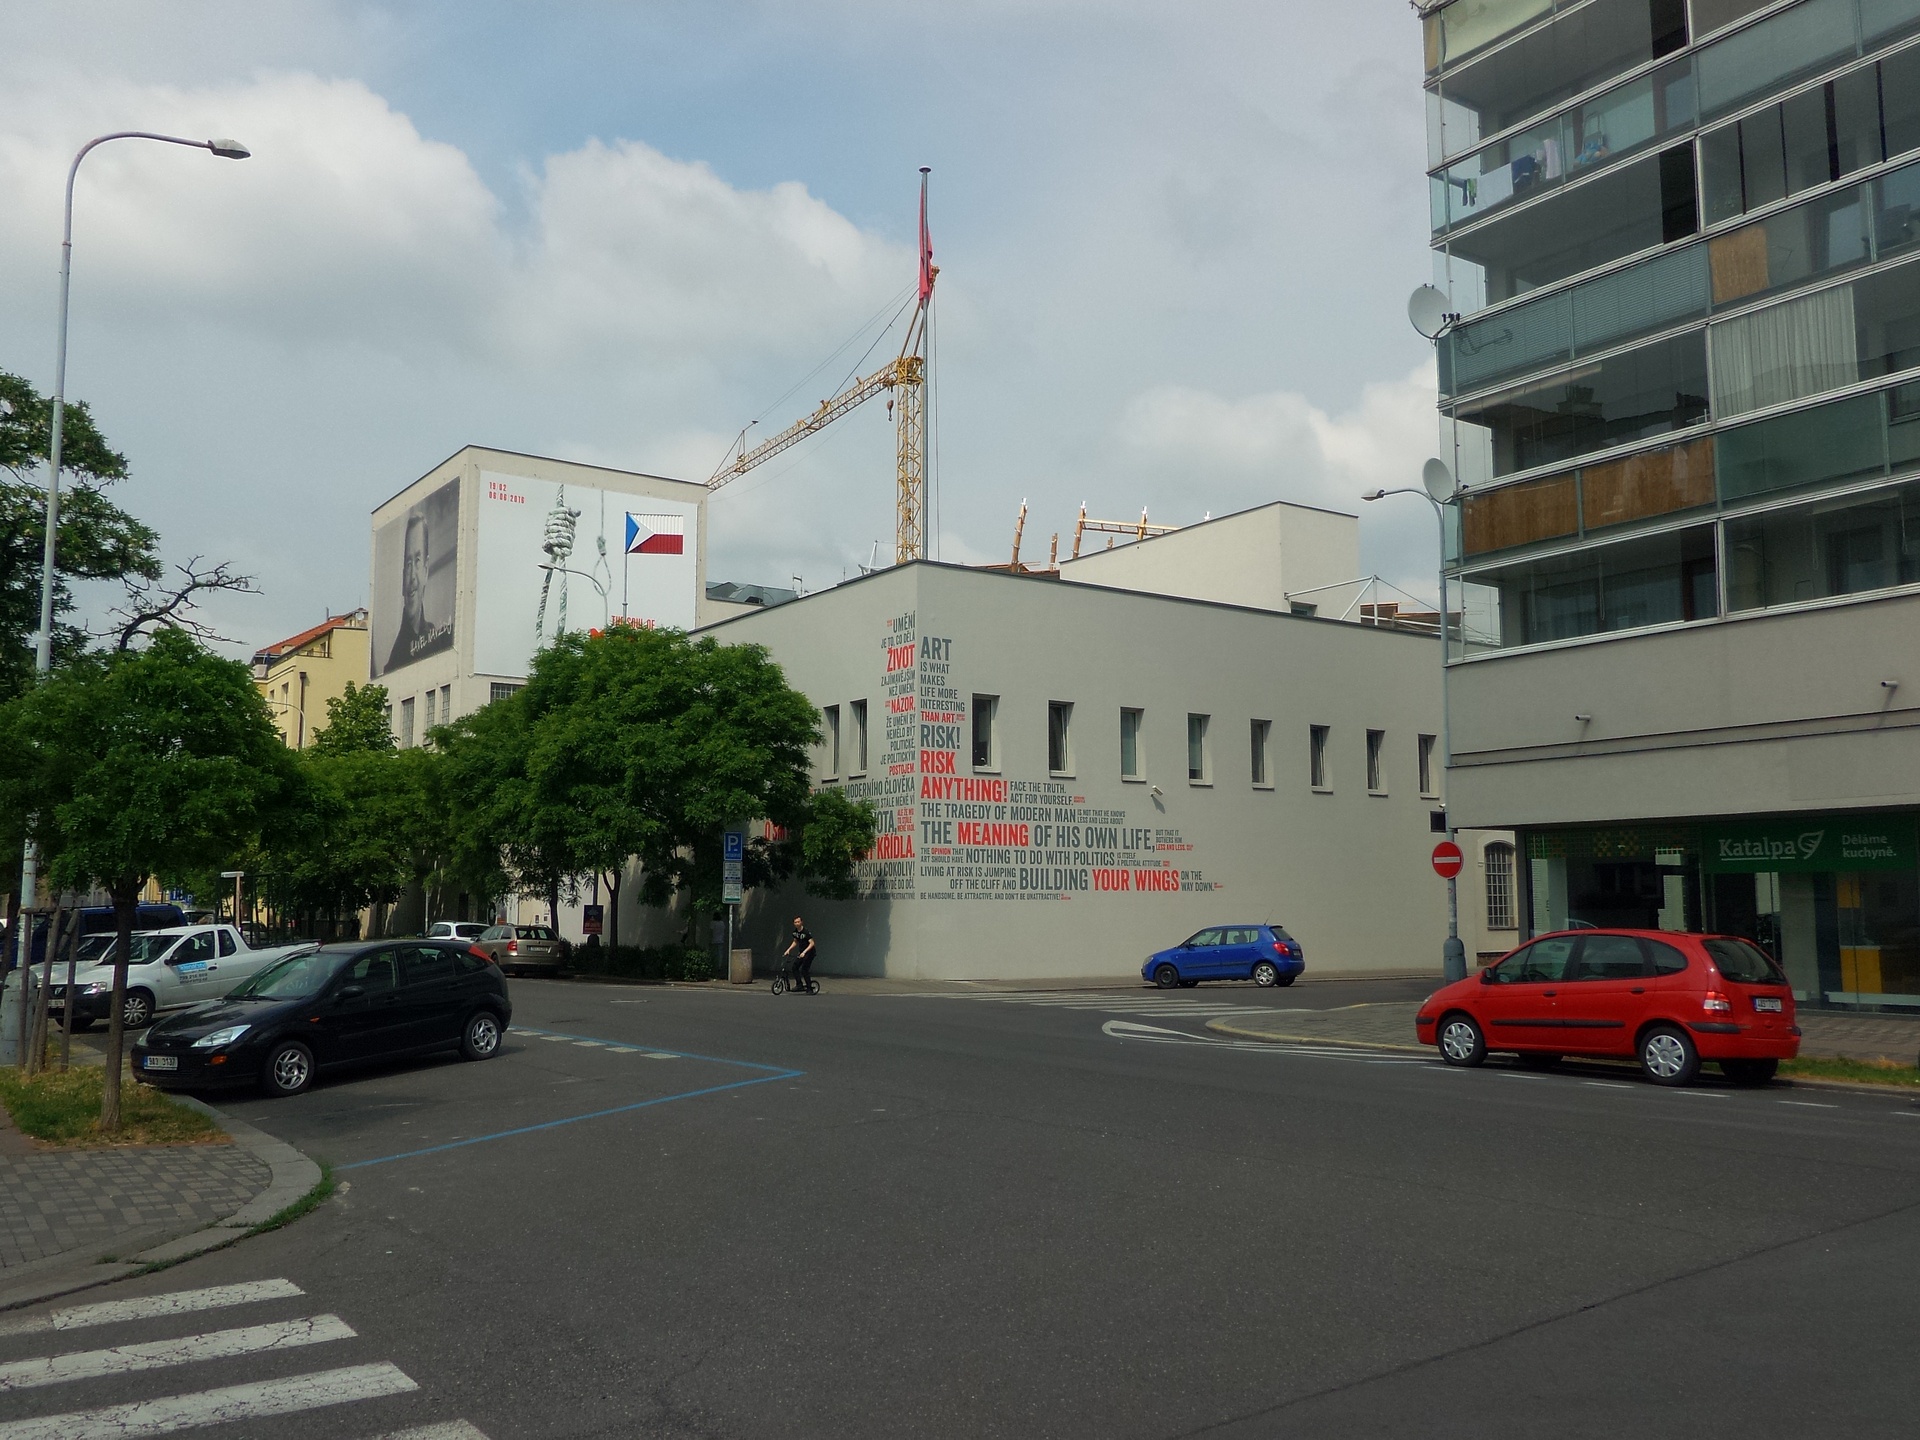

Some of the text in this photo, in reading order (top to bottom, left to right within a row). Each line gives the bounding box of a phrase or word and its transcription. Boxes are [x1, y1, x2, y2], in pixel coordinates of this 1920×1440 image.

[893, 610, 915, 633] UMĚNÍ
[881, 638, 887, 648] JE
[896, 634, 902, 646] CO
[920, 636, 952, 661] ART
[887, 644, 915, 672] ŽIVOT
[920, 662, 950, 674] IS WHAT
[920, 674, 945, 686] MAKES
[920, 686, 958, 699] LIFE MORE
[891, 695, 916, 714] NÁZOR,
[920, 699, 965, 712] INTERESTING
[921, 711, 939, 722] THAN
[942, 712, 956, 723] ART.
[921, 724, 960, 749] RISK!
[880, 754, 886, 765] JE
[921, 750, 956, 774] RISK
[845, 778, 882, 798] MODERNÍHO
[884, 775, 915, 795] ČLOVĚKA
[921, 776, 1008, 802] ANYTHING!
[1010, 781, 1066, 794] FACE THE TRUTH.
[1010, 793, 1023, 804] ACT
[1025, 794, 1038, 804] FOR
[1039, 794, 1073, 806] YOURSELF.
[921, 802, 1076, 823] THE TRAGEDY OF MODERN MAN
[728, 835, 738, 851] P
[921, 821, 1155, 852] THE MEANING OF HIS OWN LIFE,
[1842, 834, 1887, 845] Děláme
[877, 834, 915, 860] KŘÍDLA.
[1718, 837, 1796, 860] Katalpa
[1843, 847, 1897, 860] kuchyně.
[952, 856, 964, 864] HAVE
[966, 848, 1115, 866] NOTHING TO DO WITH POLITICS
[884, 861, 915, 877] COKOLIV!
[920, 866, 1016, 878] LIVING AT RISK IS JUMPING
[1181, 871, 1202, 880] ON THE
[950, 879, 1016, 890] OFF THE CLIFF AND
[1020, 868, 1179, 891] BUILDING YOUR WINGS
[1181, 882, 1194, 891] WAY
[1195, 882, 1214, 891] DOWN.
[957, 892, 963, 900] BE
